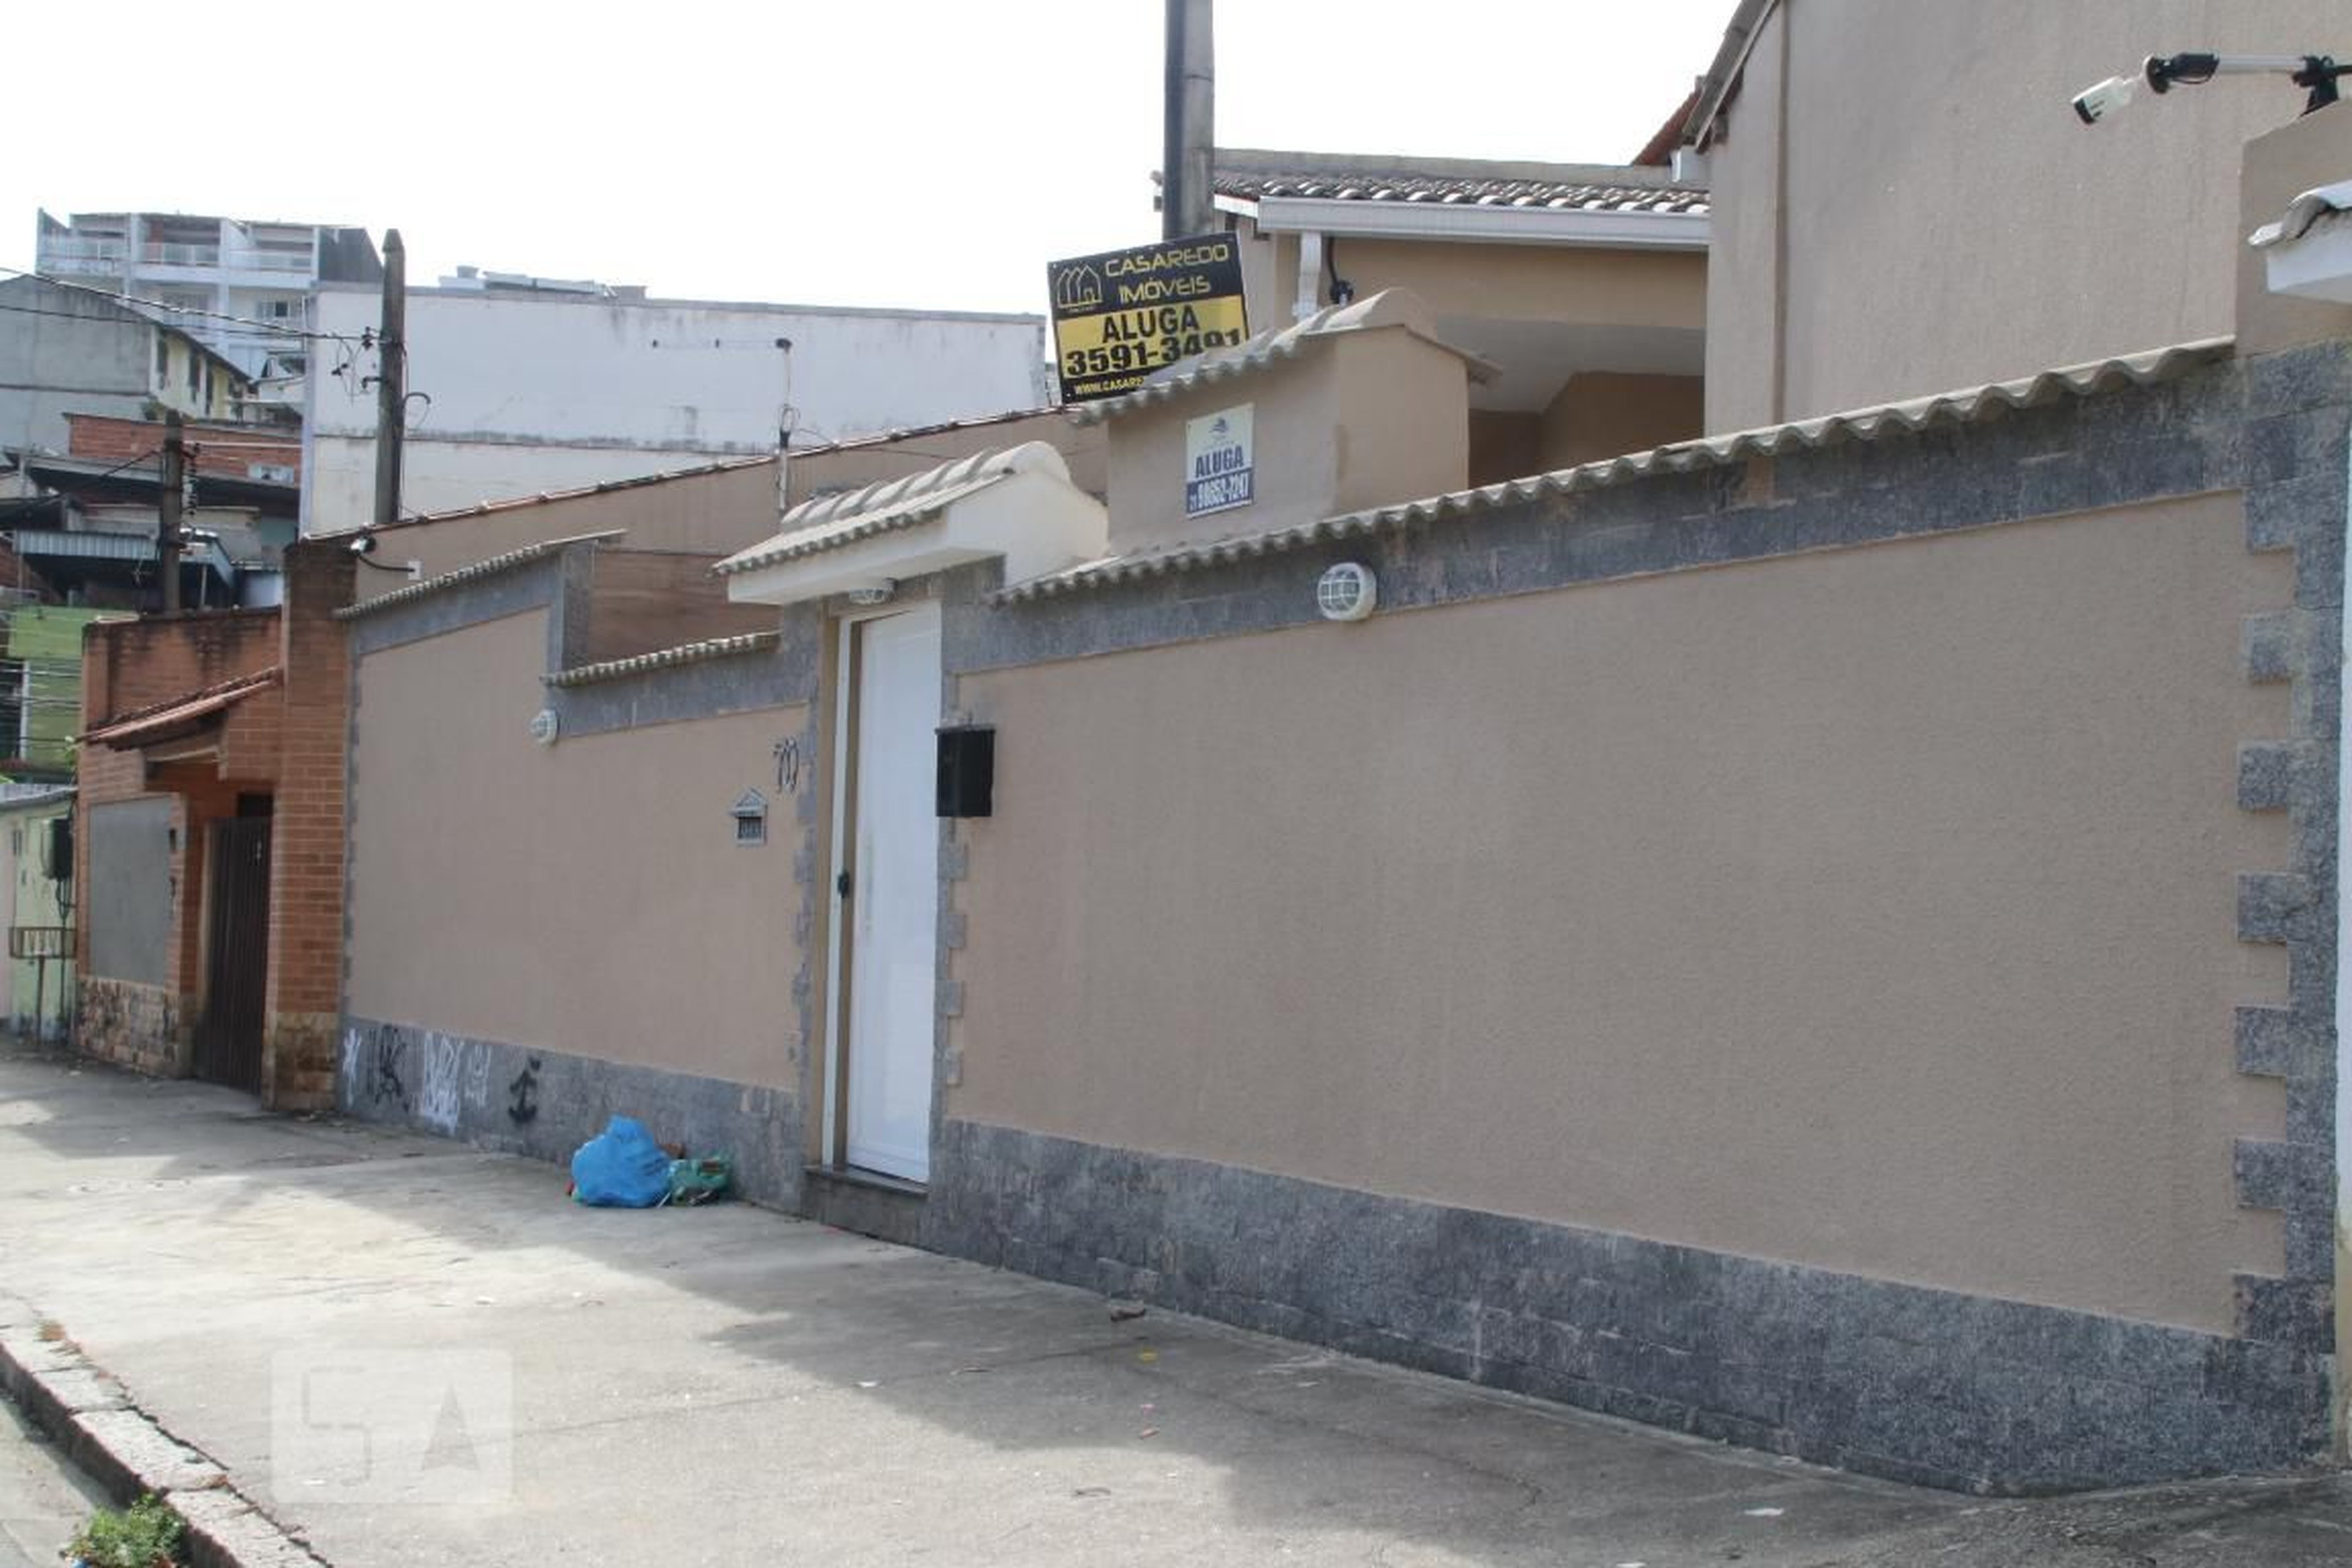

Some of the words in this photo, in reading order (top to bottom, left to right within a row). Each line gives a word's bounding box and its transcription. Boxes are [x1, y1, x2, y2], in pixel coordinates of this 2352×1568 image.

[1105, 244, 1229, 277] CASAREDO
[1118, 274, 1212, 304] IMÓVEIS
[1102, 304, 1199, 343] ALUGA
[1196, 445, 1244, 478] ALUGA
